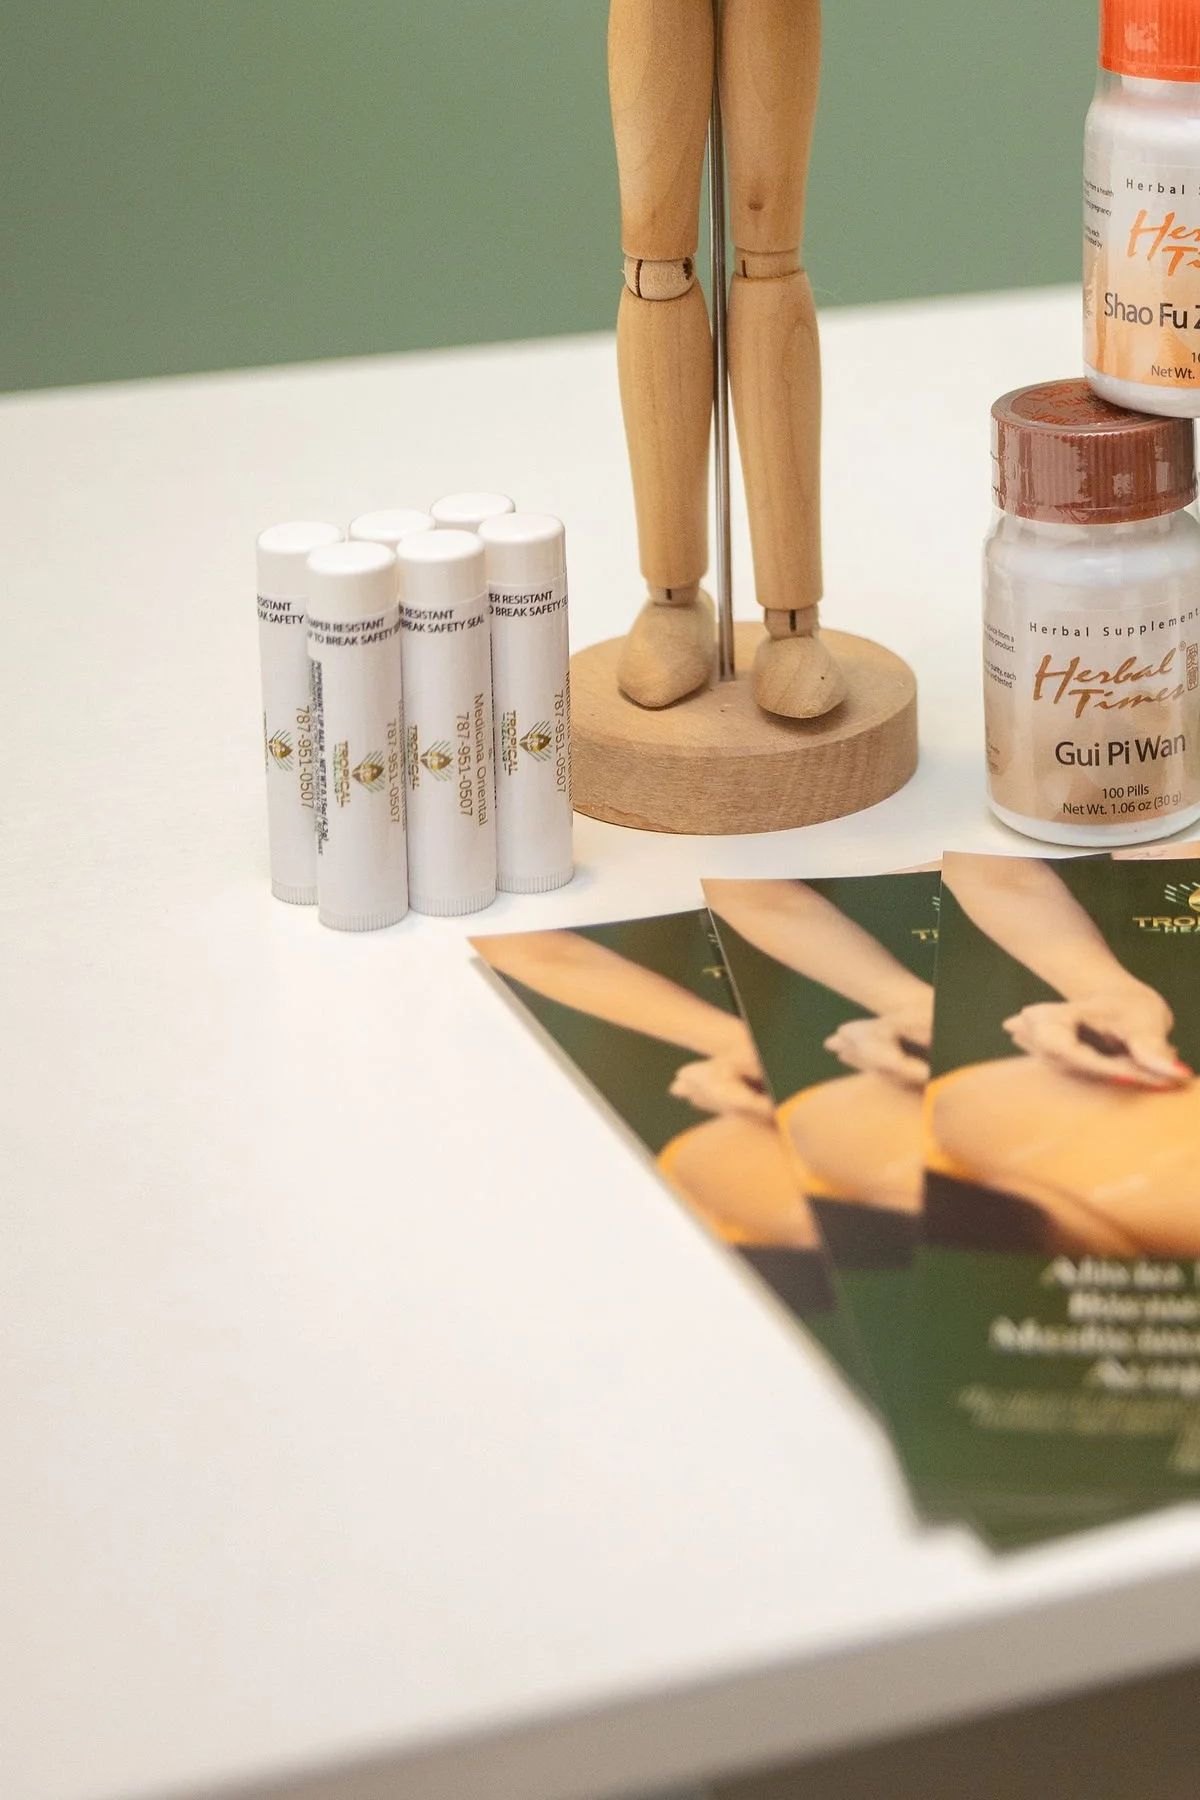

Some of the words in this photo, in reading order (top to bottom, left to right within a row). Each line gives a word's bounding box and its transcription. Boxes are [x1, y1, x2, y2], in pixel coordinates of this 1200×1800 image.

[1127, 178, 1184, 194] Herbal
[1105, 293, 1153, 325] Shao
[1160, 303, 1187, 328] Fu
[1151, 365, 1172, 377] Net
[1175, 367, 1195, 379] Wt.
[495, 607, 527, 617] BREAK
[530, 601, 561, 617] SAFETY
[502, 590, 553, 604] RESISTANT
[269, 614, 304, 625] SAFETY
[333, 617, 385, 632] RESISTANT
[401, 619, 425, 632] BREAK
[428, 621, 466, 633] SAFETY
[467, 614, 485, 629] SEAL
[405, 609, 454, 620] RESISTANT
[1030, 622, 1089, 637] Herbal
[1103, 608, 1199, 637] Supplement
[326, 635, 358, 646] BREAK
[361, 629, 392, 644] SAFETY
[1033, 648, 1176, 704] Herbal
[1069, 684, 1184, 718] Times
[474, 693, 487, 763] Medicina
[506, 710, 518, 776] TROPICAL
[554, 690, 567, 793] 787-951-0507
[296, 705, 314, 810] 787-951-0507
[409, 725, 420, 790] TROPICAL
[457, 712, 473, 816] 787-951-0507
[1056, 742, 1099, 766] Gui
[1108, 741, 1129, 764] Pi
[1136, 734, 1185, 760] Wan
[338, 740, 351, 807] TROPICAL
[387, 719, 400, 824] 787-951-0507
[477, 766, 489, 826] Oriental
[1063, 803, 1083, 814] Net
[1087, 804, 1107, 815] Wt.
[1112, 803, 1135, 814] 1.06
[1155, 796, 1169, 811] (30
[1172, 791, 1181, 807] g)
[1102, 788, 1124, 799] 100
[1128, 785, 1149, 797] Pills
